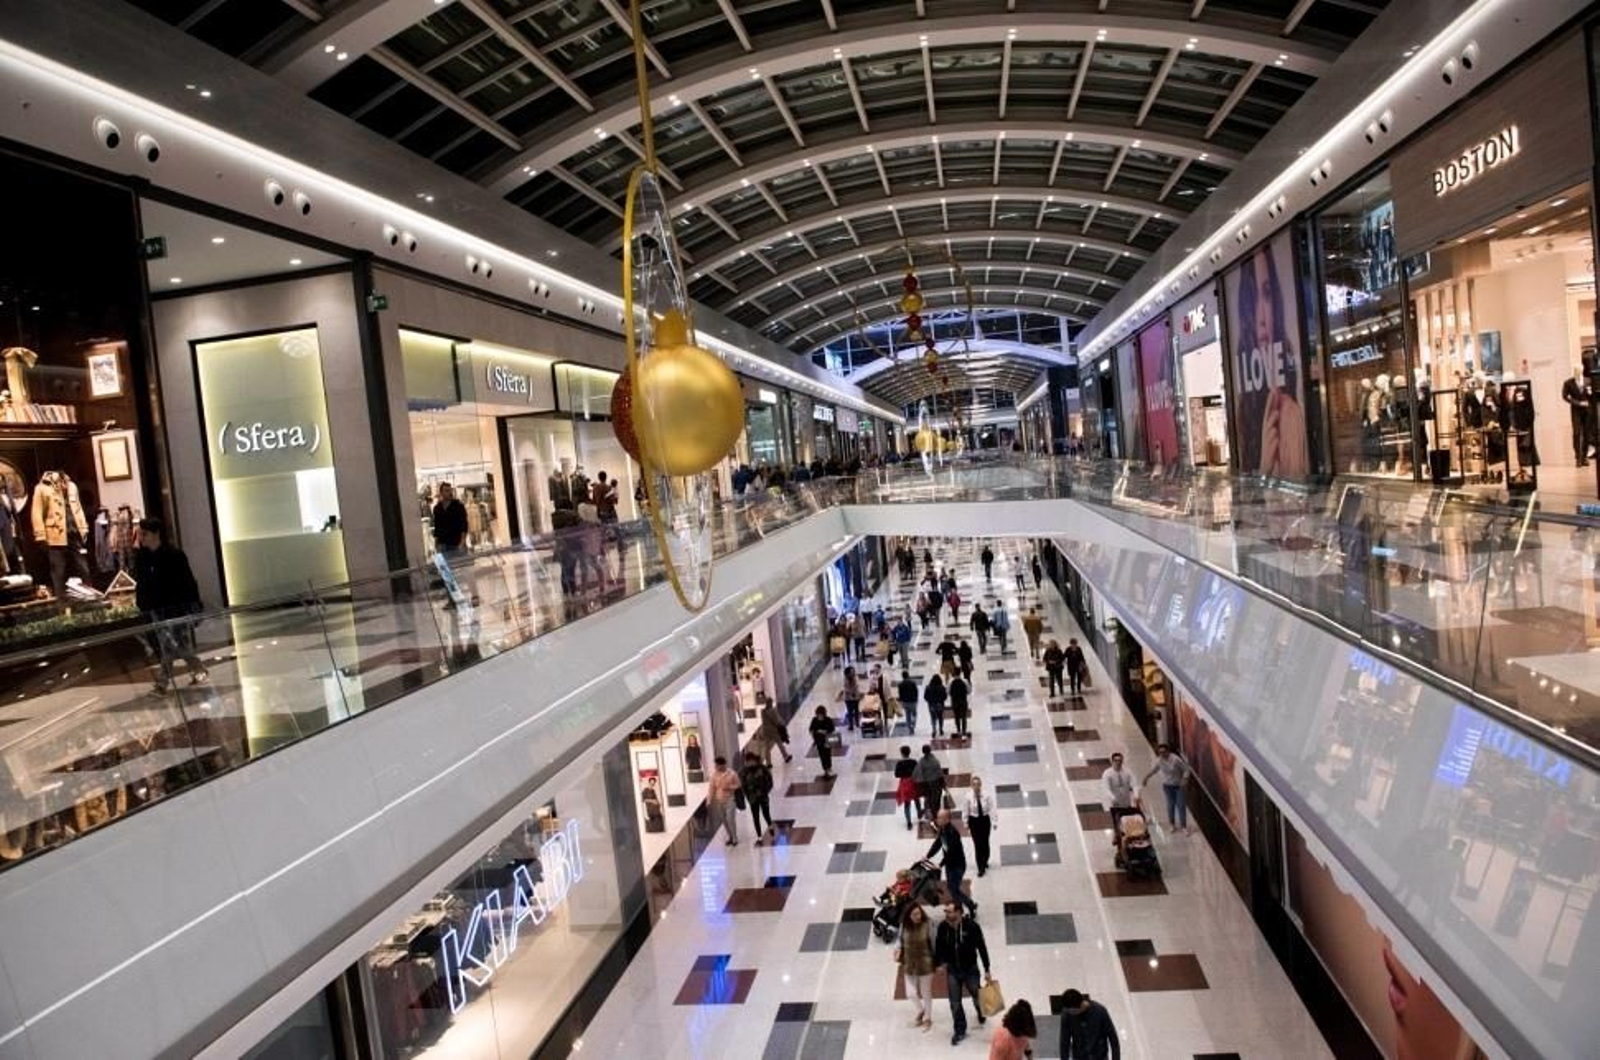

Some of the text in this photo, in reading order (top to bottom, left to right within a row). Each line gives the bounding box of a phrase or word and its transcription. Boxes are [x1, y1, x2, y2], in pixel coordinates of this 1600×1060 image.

[1432, 125, 1518, 197] BOSTON
[1242, 341, 1286, 393] LOVE
[441, 818, 582, 1015] KIABI
